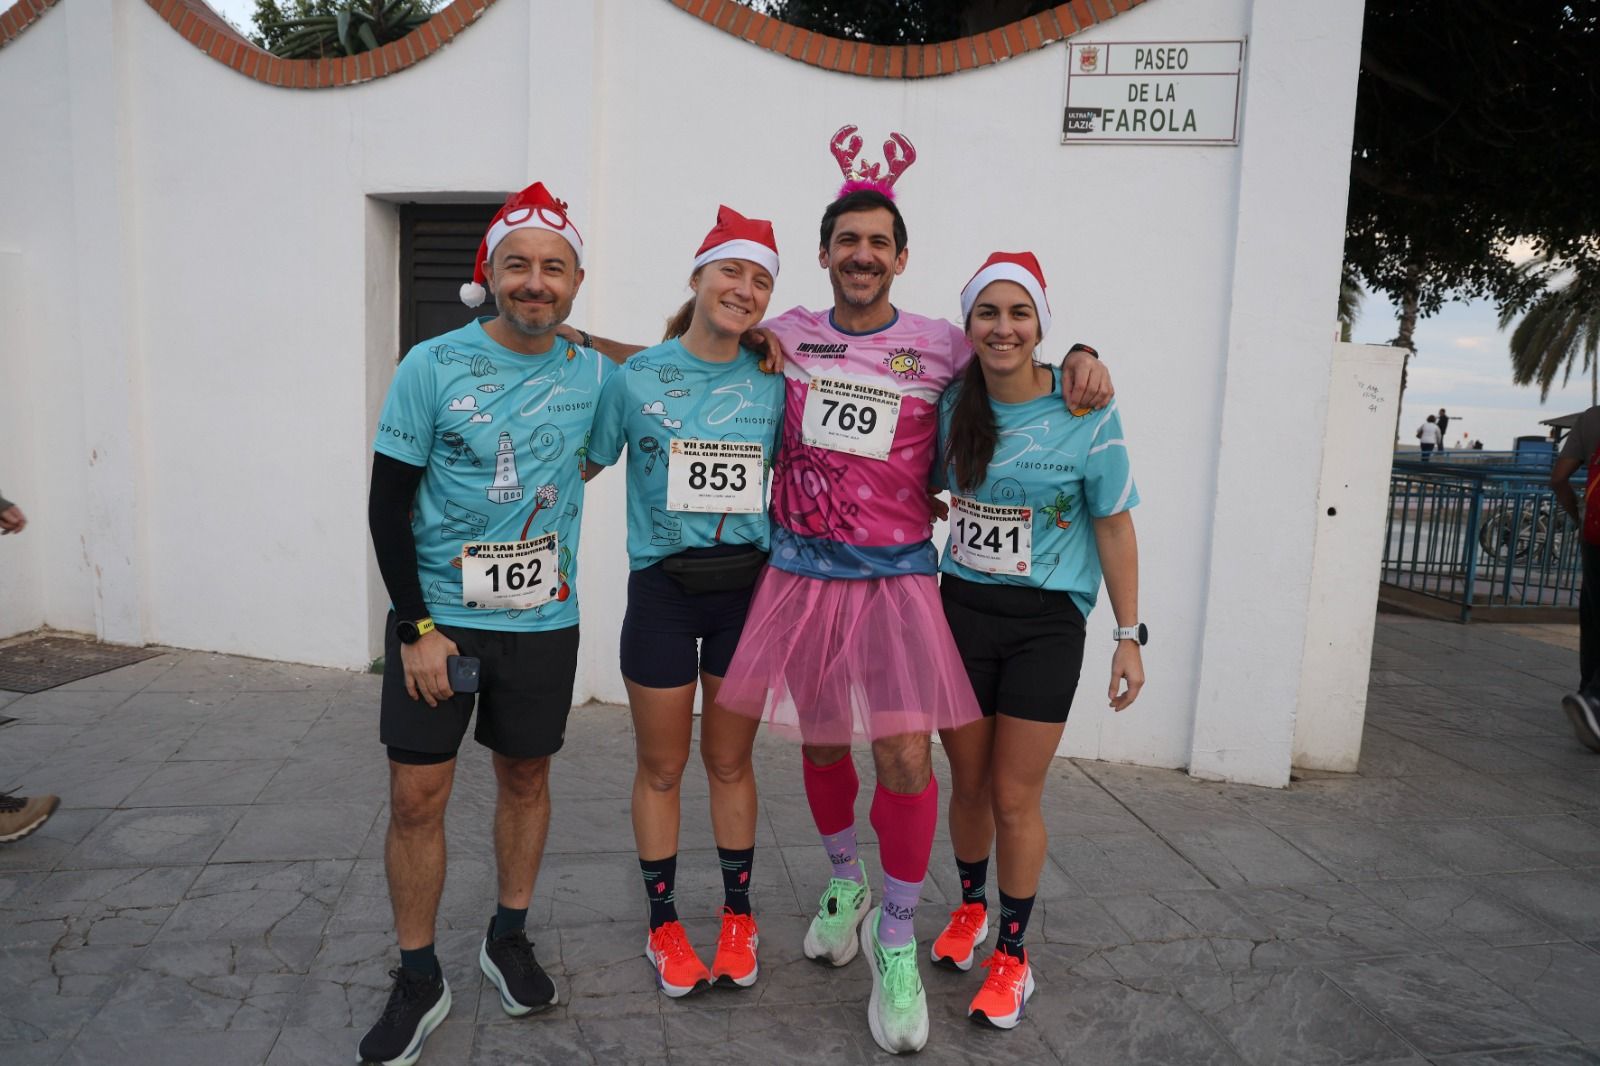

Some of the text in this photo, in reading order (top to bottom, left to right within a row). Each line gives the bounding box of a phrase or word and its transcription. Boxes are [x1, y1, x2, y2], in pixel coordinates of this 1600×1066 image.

[1135, 48, 1188, 70] PASEO
[1128, 83, 1176, 102] DE LA
[1102, 108, 1197, 132] FAROLA
[833, 381, 853, 391] SAN
[854, 385, 901, 401] SILVESTRE
[547, 401, 593, 413] FISIOSPORT
[821, 399, 877, 434] 769
[720, 444, 762, 453] SILVESTRE
[688, 461, 747, 492] 853
[1015, 461, 1076, 473] FISIOSPORT
[967, 502, 981, 511] SAN
[477, 544, 490, 552] VII
[516, 534, 556, 550] SILVESTRE
[956, 517, 1019, 553] 1241
[485, 558, 542, 592] 162
